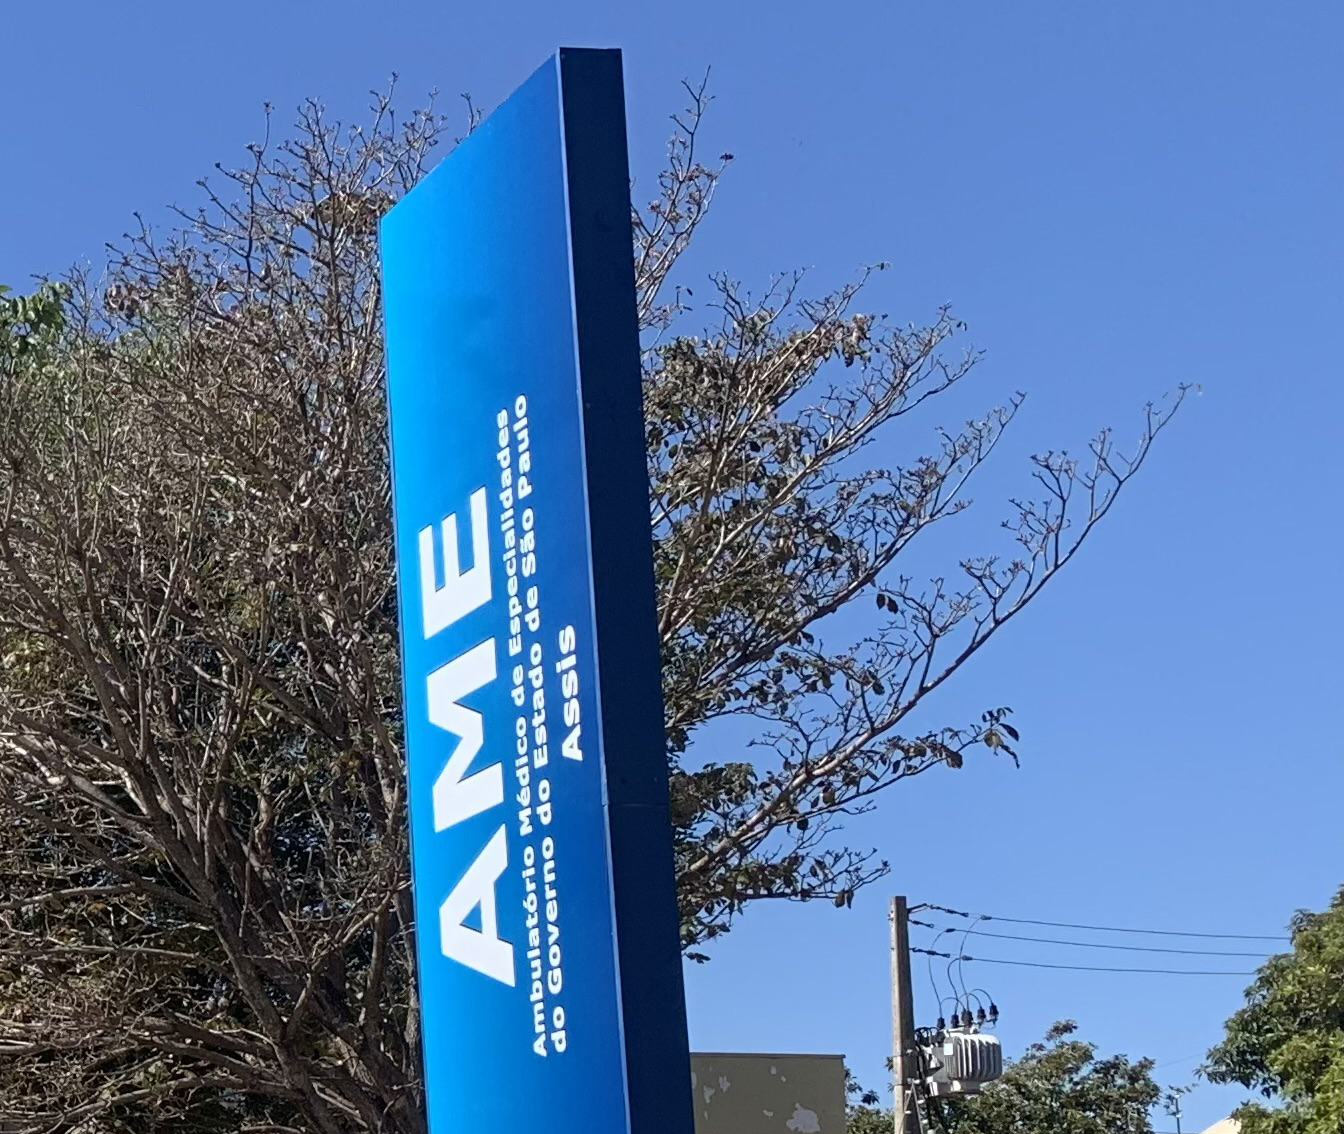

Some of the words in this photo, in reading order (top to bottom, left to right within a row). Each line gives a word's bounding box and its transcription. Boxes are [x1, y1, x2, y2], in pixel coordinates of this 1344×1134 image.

[513, 395, 532, 500] Paulo
[497, 409, 522, 656] Especialidades
[520, 508, 535, 577] São
[525, 586, 539, 632] de
[418, 485, 515, 987] AME
[511, 664, 524, 707] de
[528, 642, 548, 769] Estado
[556, 625, 583, 761] Assis
[515, 716, 533, 836] Médico
[537, 778, 552, 825] do
[522, 846, 547, 1057] Ambulatório
[542, 836, 562, 994] Governo
[551, 1006, 566, 1052] do
